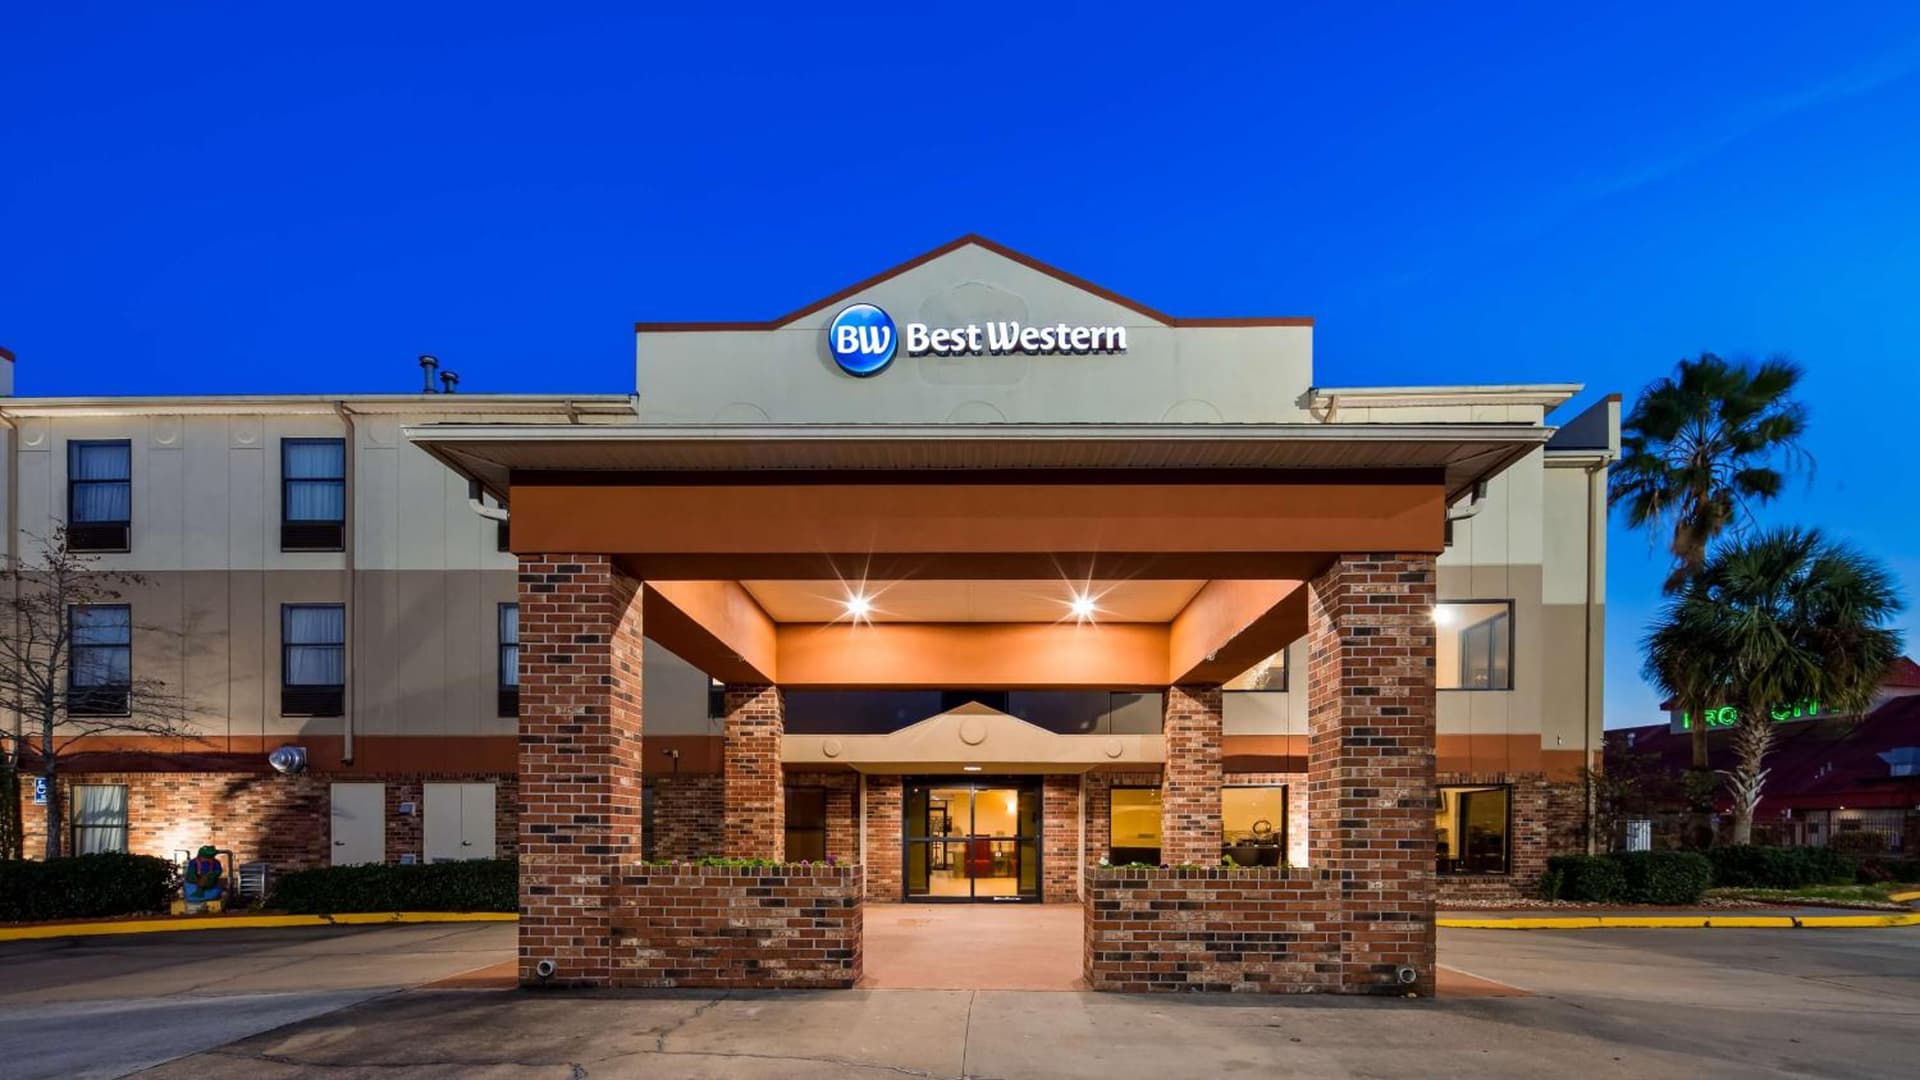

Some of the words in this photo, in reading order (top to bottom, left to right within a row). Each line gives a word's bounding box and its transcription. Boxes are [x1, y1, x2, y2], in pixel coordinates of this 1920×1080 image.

[837, 325, 891, 354] BW
[906, 323, 983, 352] Best
[986, 321, 1128, 350] Western
